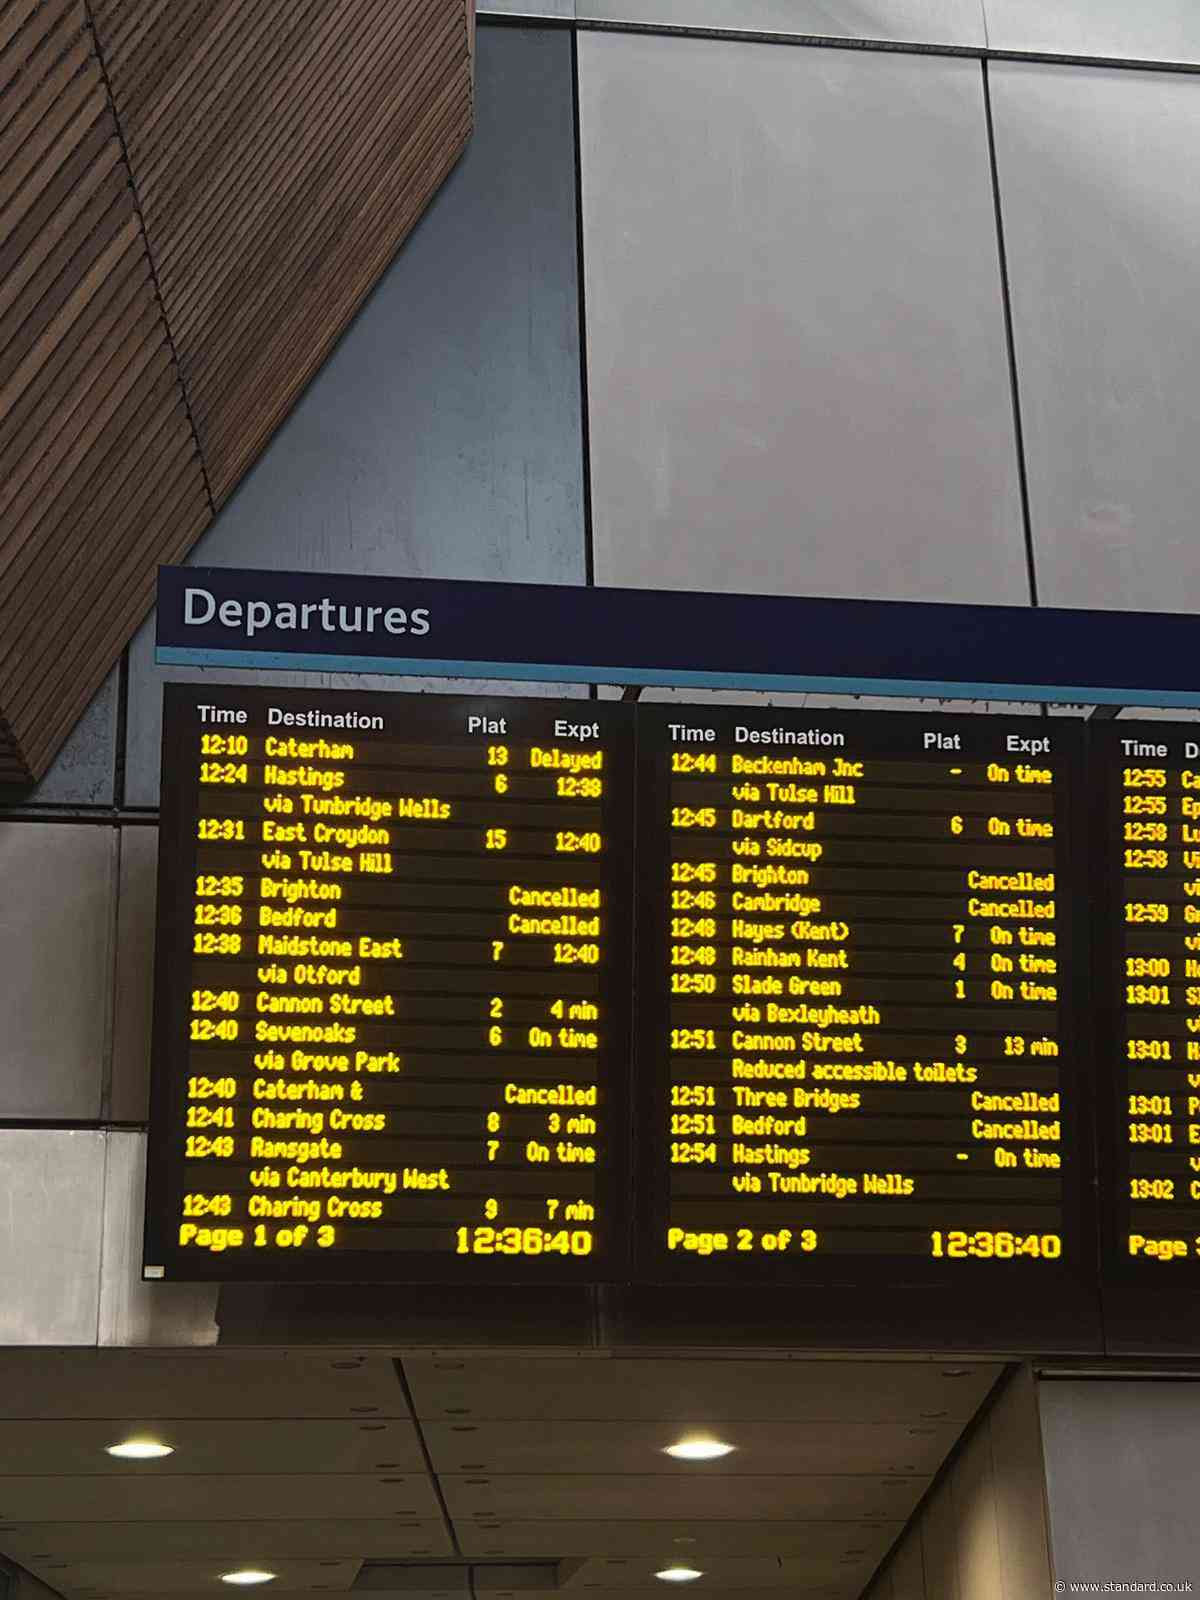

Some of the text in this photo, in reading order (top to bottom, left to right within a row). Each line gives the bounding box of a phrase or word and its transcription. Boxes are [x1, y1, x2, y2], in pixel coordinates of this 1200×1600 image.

[184, 587, 431, 636] Departures
[197, 705, 600, 742] Time Destination Plat Expt
[201, 734, 602, 773] 12:10 Caterham 13 Delayed
[668, 724, 1051, 756] Time Destination Plat Expt
[1121, 740, 1168, 757] Time
[672, 753, 864, 777] 12:44 Beckenham Jnc
[200, 763, 602, 797] 12:24 Hastings 6 12:38
[732, 782, 855, 804] via Tulse Hill
[264, 794, 450, 821] via Tunbridge Wells
[672, 808, 963, 834] 12:45 Dartford 6
[198, 819, 601, 852] 12:31 East Croydon 15 12:40
[732, 837, 822, 861] via Sidcup
[262, 850, 393, 873] via Tulse Hill
[672, 863, 1054, 891] 12:45 Brighton Cancelled
[196, 876, 600, 908] 12:35 Brighton Cancelled
[672, 890, 1055, 918] 12:46 Cambridge Cancelled
[195, 904, 599, 936] 12:36 Bedford Cancelled
[671, 918, 716, 937] 12:48
[732, 919, 784, 943] Hayes
[953, 925, 964, 943] 7
[194, 933, 599, 964] 12:38 Maidstone East 7 12:40
[671, 946, 965, 971] 12:48 Rainham Kent 4
[258, 964, 361, 986] via Otford
[672, 973, 965, 998] 12:50 Slade Green 1
[192, 990, 598, 1020] 12:40 Cannon Street 2 4 min
[732, 1003, 880, 1028] via Bexleyheath
[190, 1019, 597, 1049] 12:40 Sevenoaks 6 On time
[671, 1029, 1058, 1056] 12:51 Cannon Street 3 13 min
[254, 1050, 400, 1073] via Grove Park
[732, 1058, 977, 1082] Reduced accessible toilets
[188, 1077, 596, 1105] 12:40 Caterham Cancelled
[671, 1086, 1059, 1112] 12:51 Three Bridges Cancelled
[187, 1106, 596, 1134] 12:41 Charing Cross 8 3 min
[671, 1114, 1060, 1140] 12:51 Bedford Cancelled
[186, 1136, 499, 1163] 12:43 Ramsgate 7
[671, 1143, 810, 1169] 12:54 Hastings
[250, 1166, 450, 1193] via Canterbury West
[732, 1172, 913, 1198] via Tunbridge Wells
[183, 1194, 594, 1222] 12:43 Charing Cross 9 7 min
[180, 1224, 592, 1255] Page 1 of 3 12:36:40
[668, 1228, 1061, 1258] Page 2 of 3 12:36:40
